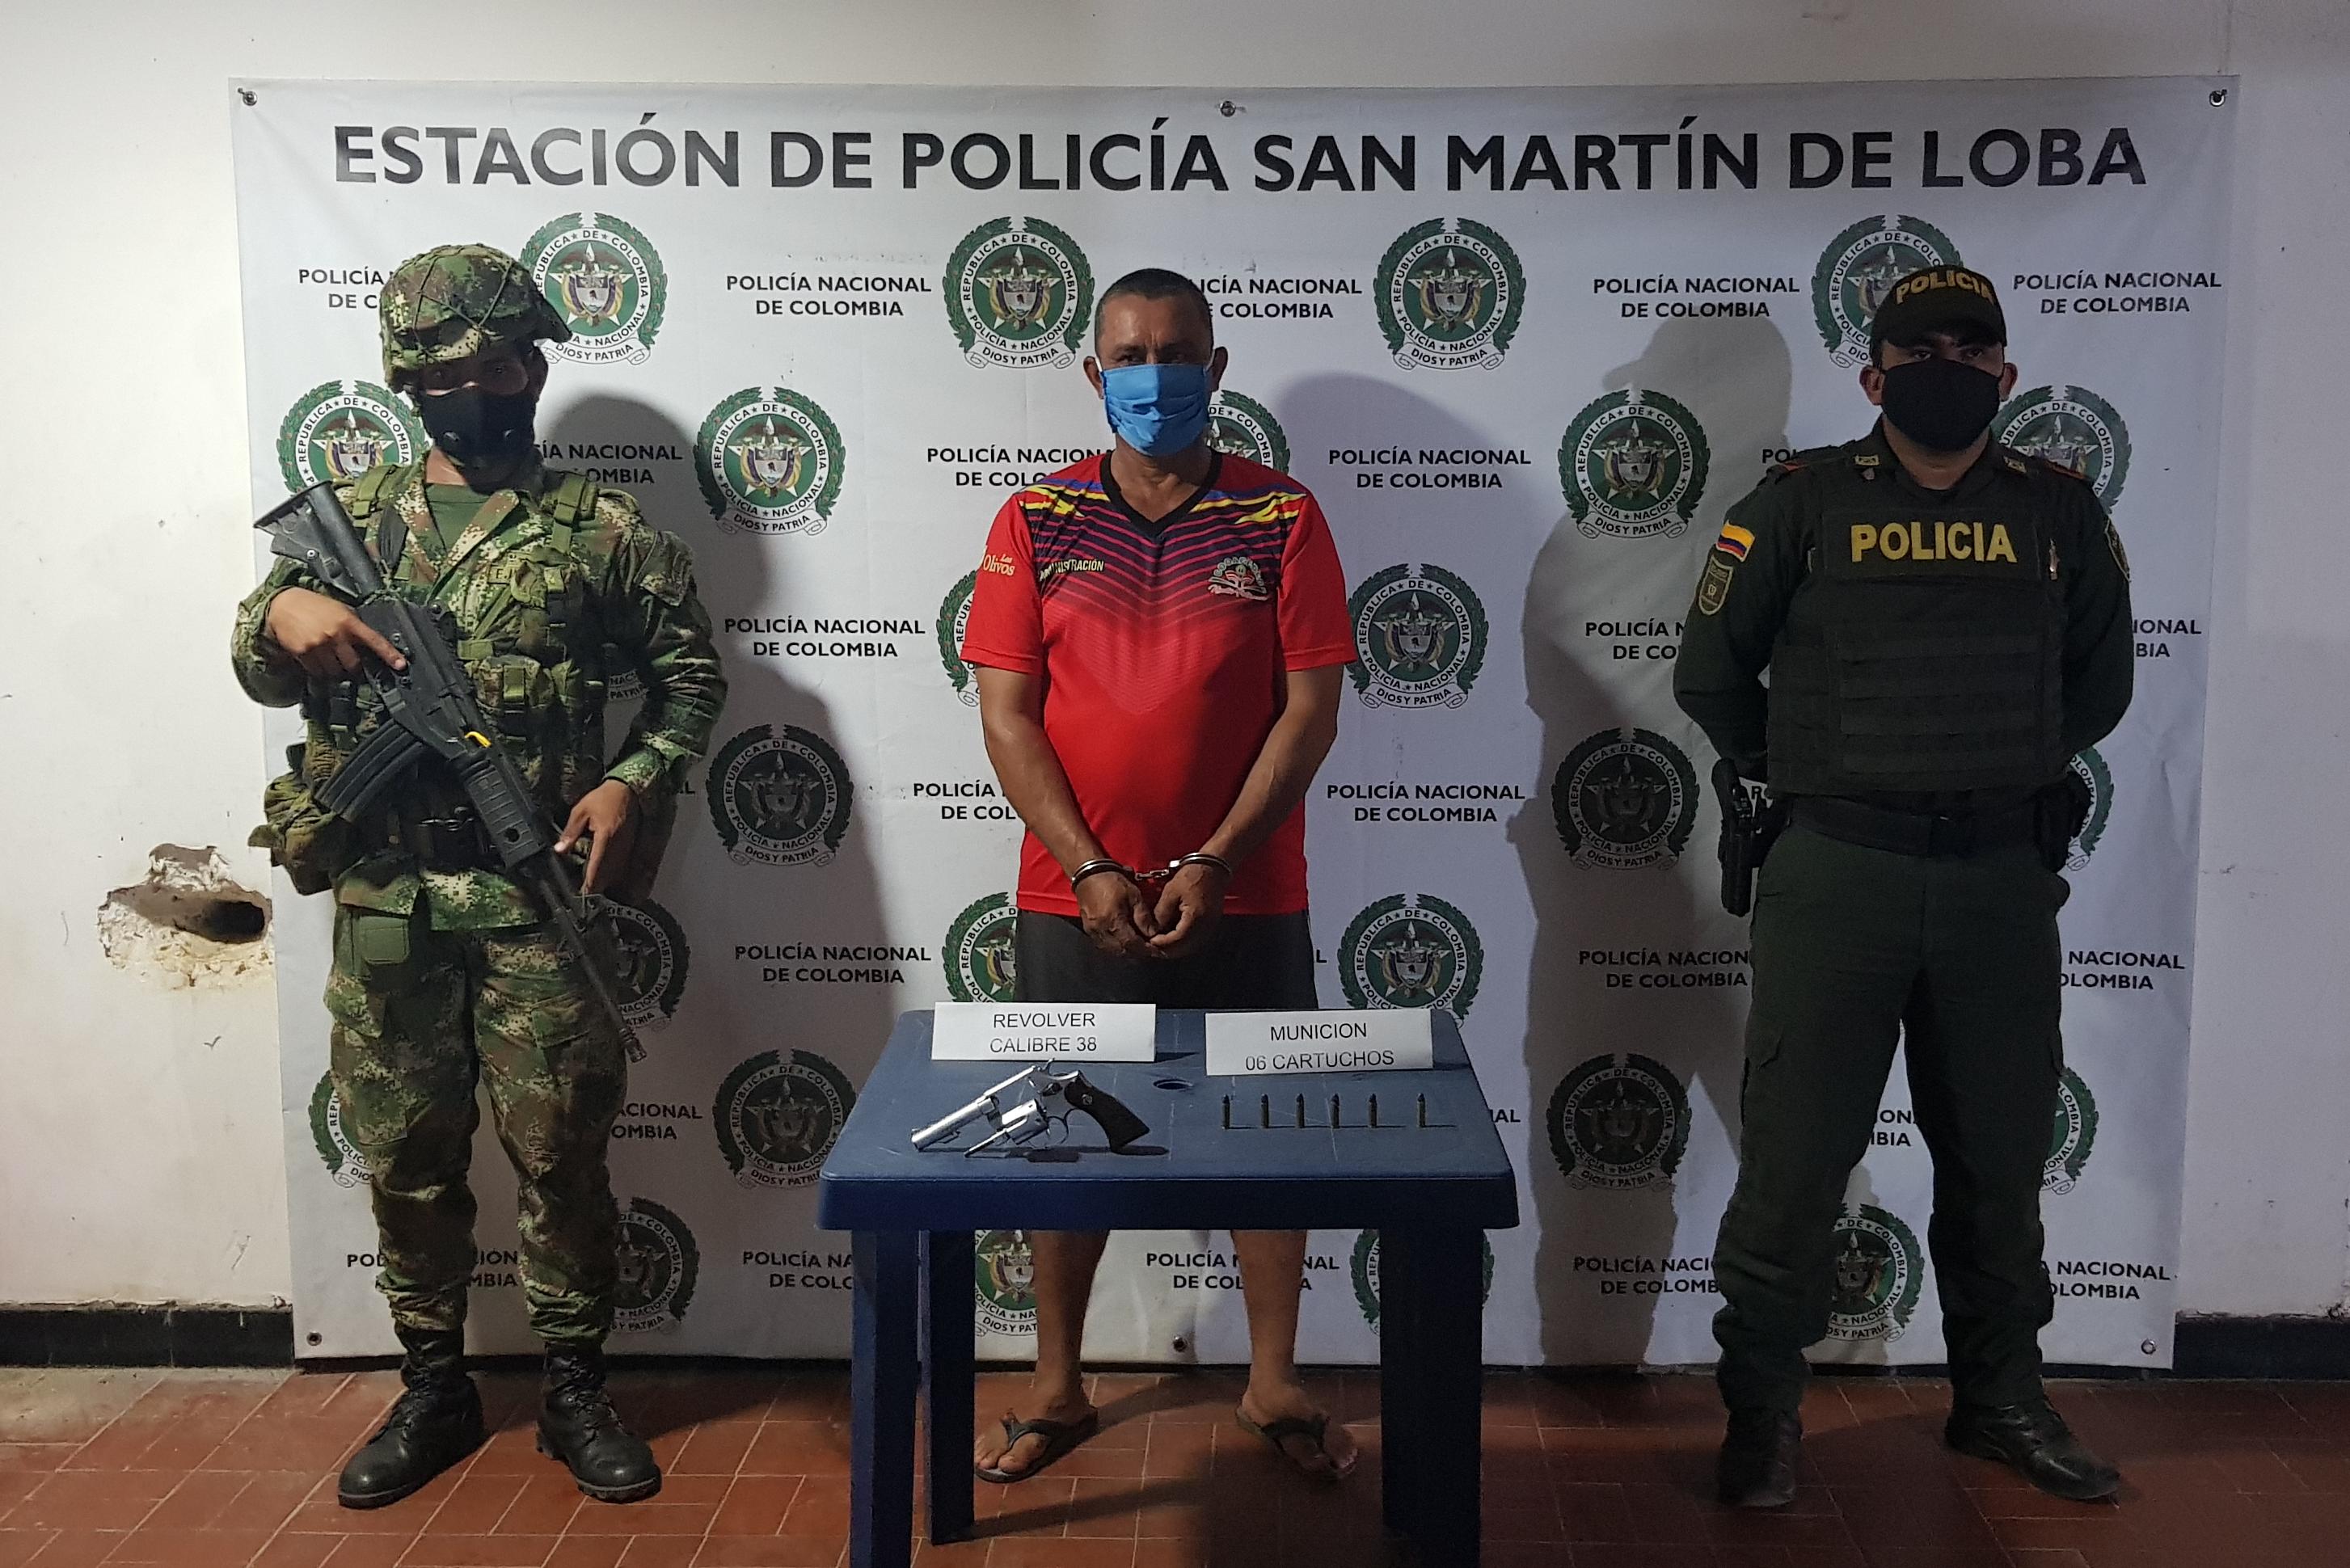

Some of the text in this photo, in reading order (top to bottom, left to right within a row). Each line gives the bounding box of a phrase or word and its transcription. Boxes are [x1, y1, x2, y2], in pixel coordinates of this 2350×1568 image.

[335, 112, 2145, 192] ESTACIÓN DE POLICÍA SAN MARTÍN DE LOBA
[1885, 233, 1901, 241] DE
[583, 230, 648, 297] DE COLOMBIA
[1012, 234, 1027, 242] DE
[1040, 242, 1075, 301] COLOMBIA
[1473, 242, 1506, 301] COLOMBIA
[299, 266, 383, 285] POLICÍA
[728, 272, 931, 292] POLICÍA NACIONAL
[1594, 274, 1799, 293] POLICÍA NACIONAL
[2014, 270, 2221, 289] POLICÍA NACIONAL
[1250, 280, 1362, 293] NACIONAL
[1896, 270, 1993, 305] POLICIA
[329, 293, 357, 308] DE
[757, 301, 903, 315] DE COLOMBIA
[2041, 297, 2189, 314] DE COLOMBIA
[1221, 303, 1333, 318] COLOMBIA
[1622, 302, 1770, 317] DE COLOMBIA
[595, 312, 644, 346] NACIONAL
[1021, 316, 1071, 350] NACIONAL
[1450, 317, 1501, 351] NACIONAL
[596, 344, 633, 360] PATRIA
[1021, 348, 1058, 365] PATRIA
[1449, 349, 1487, 365] PATRIA
[372, 405, 407, 463] COLOMBIA
[791, 411, 826, 469] COLOMBIA
[1237, 414, 1271, 462] COLOMBI
[1657, 414, 1690, 471] COLOMBIA
[2079, 410, 2112, 467] COLOMBIA
[569, 445, 682, 460] NACIONAL
[928, 445, 1010, 462] POLICÍA
[1330, 446, 1531, 464] POLICÍA NACIONAL
[956, 472, 981, 486] DE
[1357, 474, 1502, 487] DE COLOMBIA
[773, 484, 822, 516] NACIONAL
[1635, 487, 1685, 520] NACIONAL
[773, 515, 810, 531] PATRIA
[1634, 518, 1671, 534] PATRIA
[1850, 522, 2017, 563] POLICIA
[1437, 588, 1469, 643] COLOMBIA
[725, 615, 925, 634] POLICÍA NACIONAL
[1586, 618, 1669, 636] POLICÍA
[754, 642, 897, 656] DE COLOMBIA
[1614, 646, 1639, 659] DE
[1415, 658, 1464, 690] NACIONAL
[1414, 689, 1451, 705] PATRIA
[914, 780, 995, 797] POLICÍA
[1327, 782, 1525, 799] POLICÍA NACIONAL
[942, 806, 967, 819] DE
[1355, 807, 1496, 821] DE COLOMBIA
[736, 942, 931, 962] POLICÍA NACIONAL
[1432, 917, 1465, 971] COLOMBIA
[1580, 948, 1661, 967] POLICÍA
[2069, 951, 2185, 969] NACIONAL
[763, 968, 904, 983] DE COLOMBIA
[1606, 972, 1747, 988] DE COLOMBIA
[994, 1014, 1095, 1028] REVOLVER
[1271, 1023, 1366, 1040] MUNICION
[990, 1037, 1096, 1052] CALIBRE 38
[1246, 1051, 1394, 1070] 06 CARTUCHOS
[744, 1250, 821, 1268] POLICÍA
[1147, 1250, 1226, 1267] POLICÍA
[1874, 1225, 1905, 1279] COLOMBIA
[1573, 1256, 1655, 1273] POLICÍA
[2057, 1262, 2171, 1280] NACIONAL
[770, 1274, 795, 1288] DE
[1174, 1275, 1198, 1288] DE
[1601, 1280, 1626, 1294] DE
[1853, 1292, 1901, 1324] NACIONAL
[1852, 1322, 1888, 1338] PATRIA
